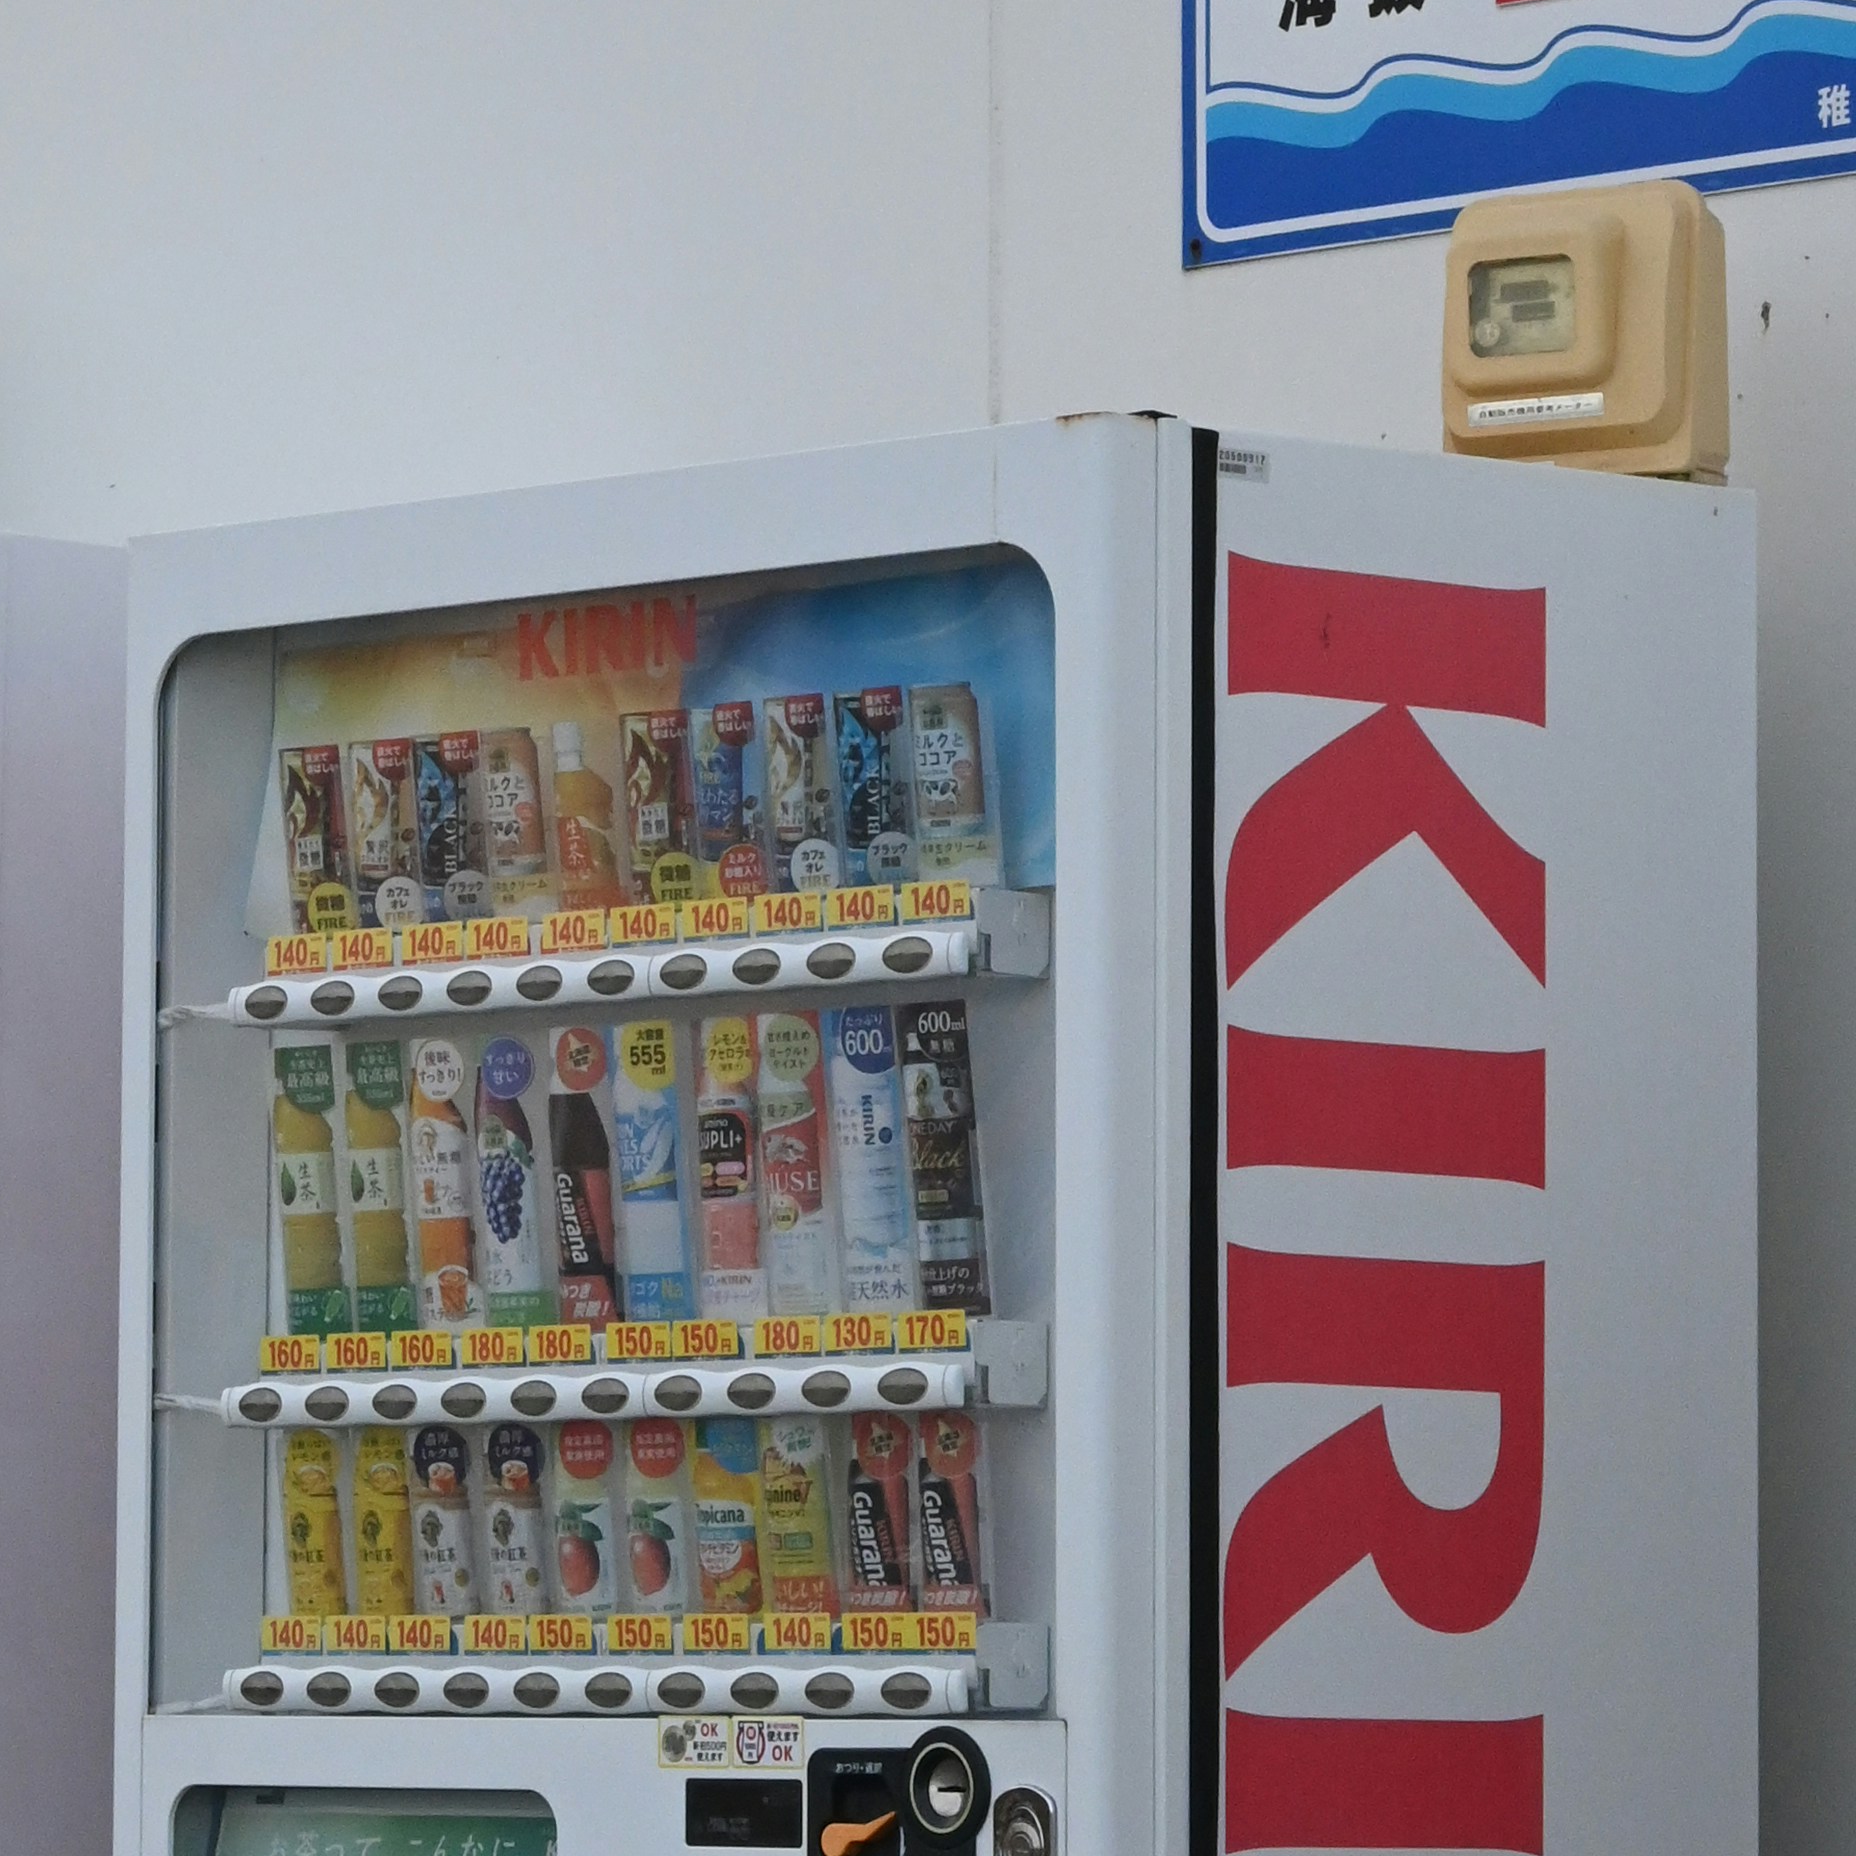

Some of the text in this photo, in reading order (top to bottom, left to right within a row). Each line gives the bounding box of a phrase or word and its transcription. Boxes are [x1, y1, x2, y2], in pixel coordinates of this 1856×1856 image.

[1817, 83, 1851, 129] 稚
[517, 594, 697, 682] KIRIN
[919, 749, 958, 767] ココア
[866, 766, 880, 835] BLACK
[445, 809, 458, 874] BLACK
[629, 1044, 666, 1065] 555
[844, 1029, 883, 1056] 600
[419, 1067, 462, 1084] すっきり!
[861, 1094, 875, 1146] KIRIN
[556, 1173, 589, 1265] Guarana
[700, 1723, 719, 1737] OK
[772, 1745, 793, 1761] OK
